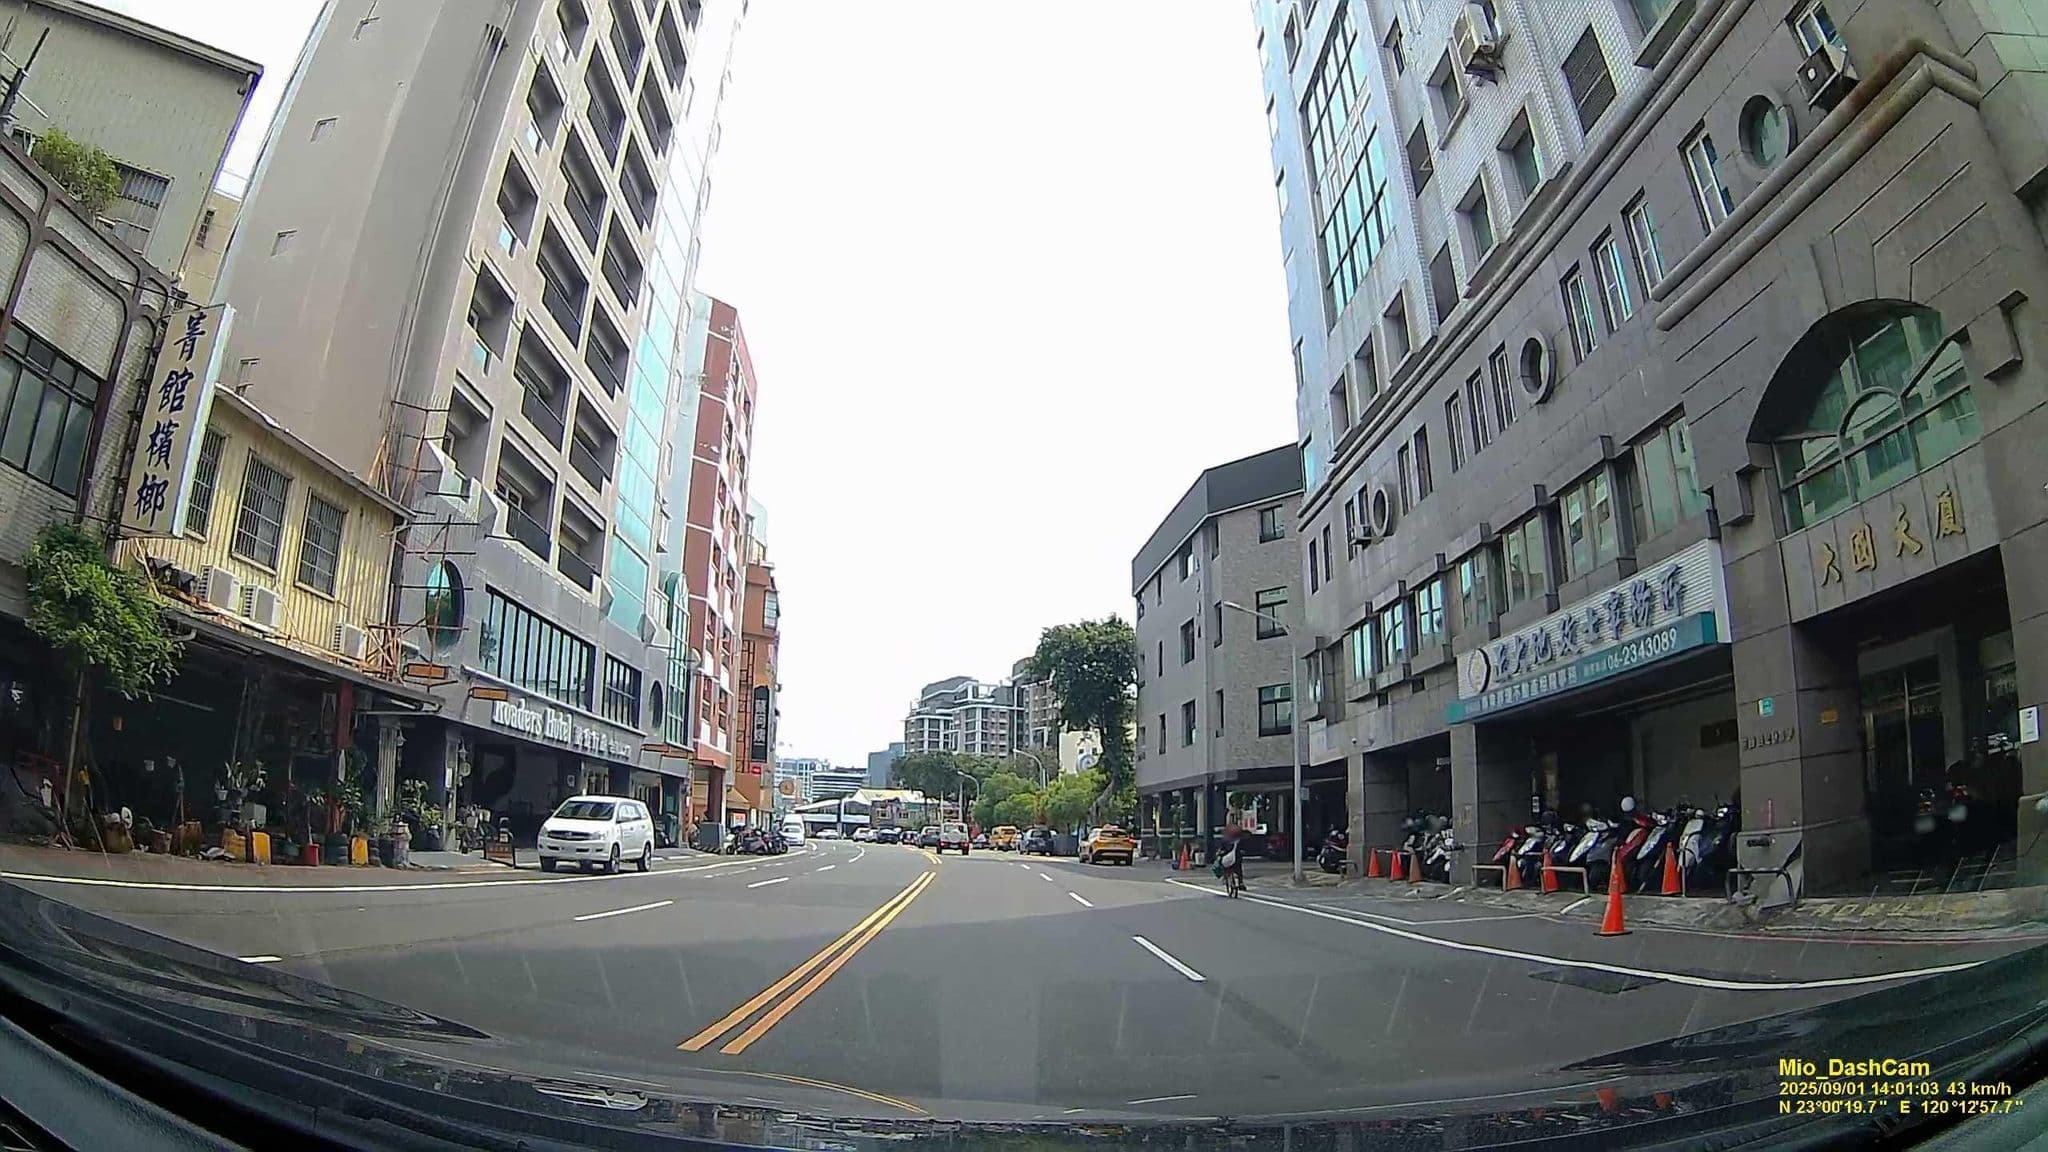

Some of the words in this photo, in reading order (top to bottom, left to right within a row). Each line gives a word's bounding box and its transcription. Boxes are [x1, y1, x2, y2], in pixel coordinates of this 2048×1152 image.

[135, 311, 208, 527] 菁館檳榔
[1606, 627, 1678, 670] 06-2343089
[492, 698, 543, 737] Roaders
[545, 706, 573, 744] Hotel
